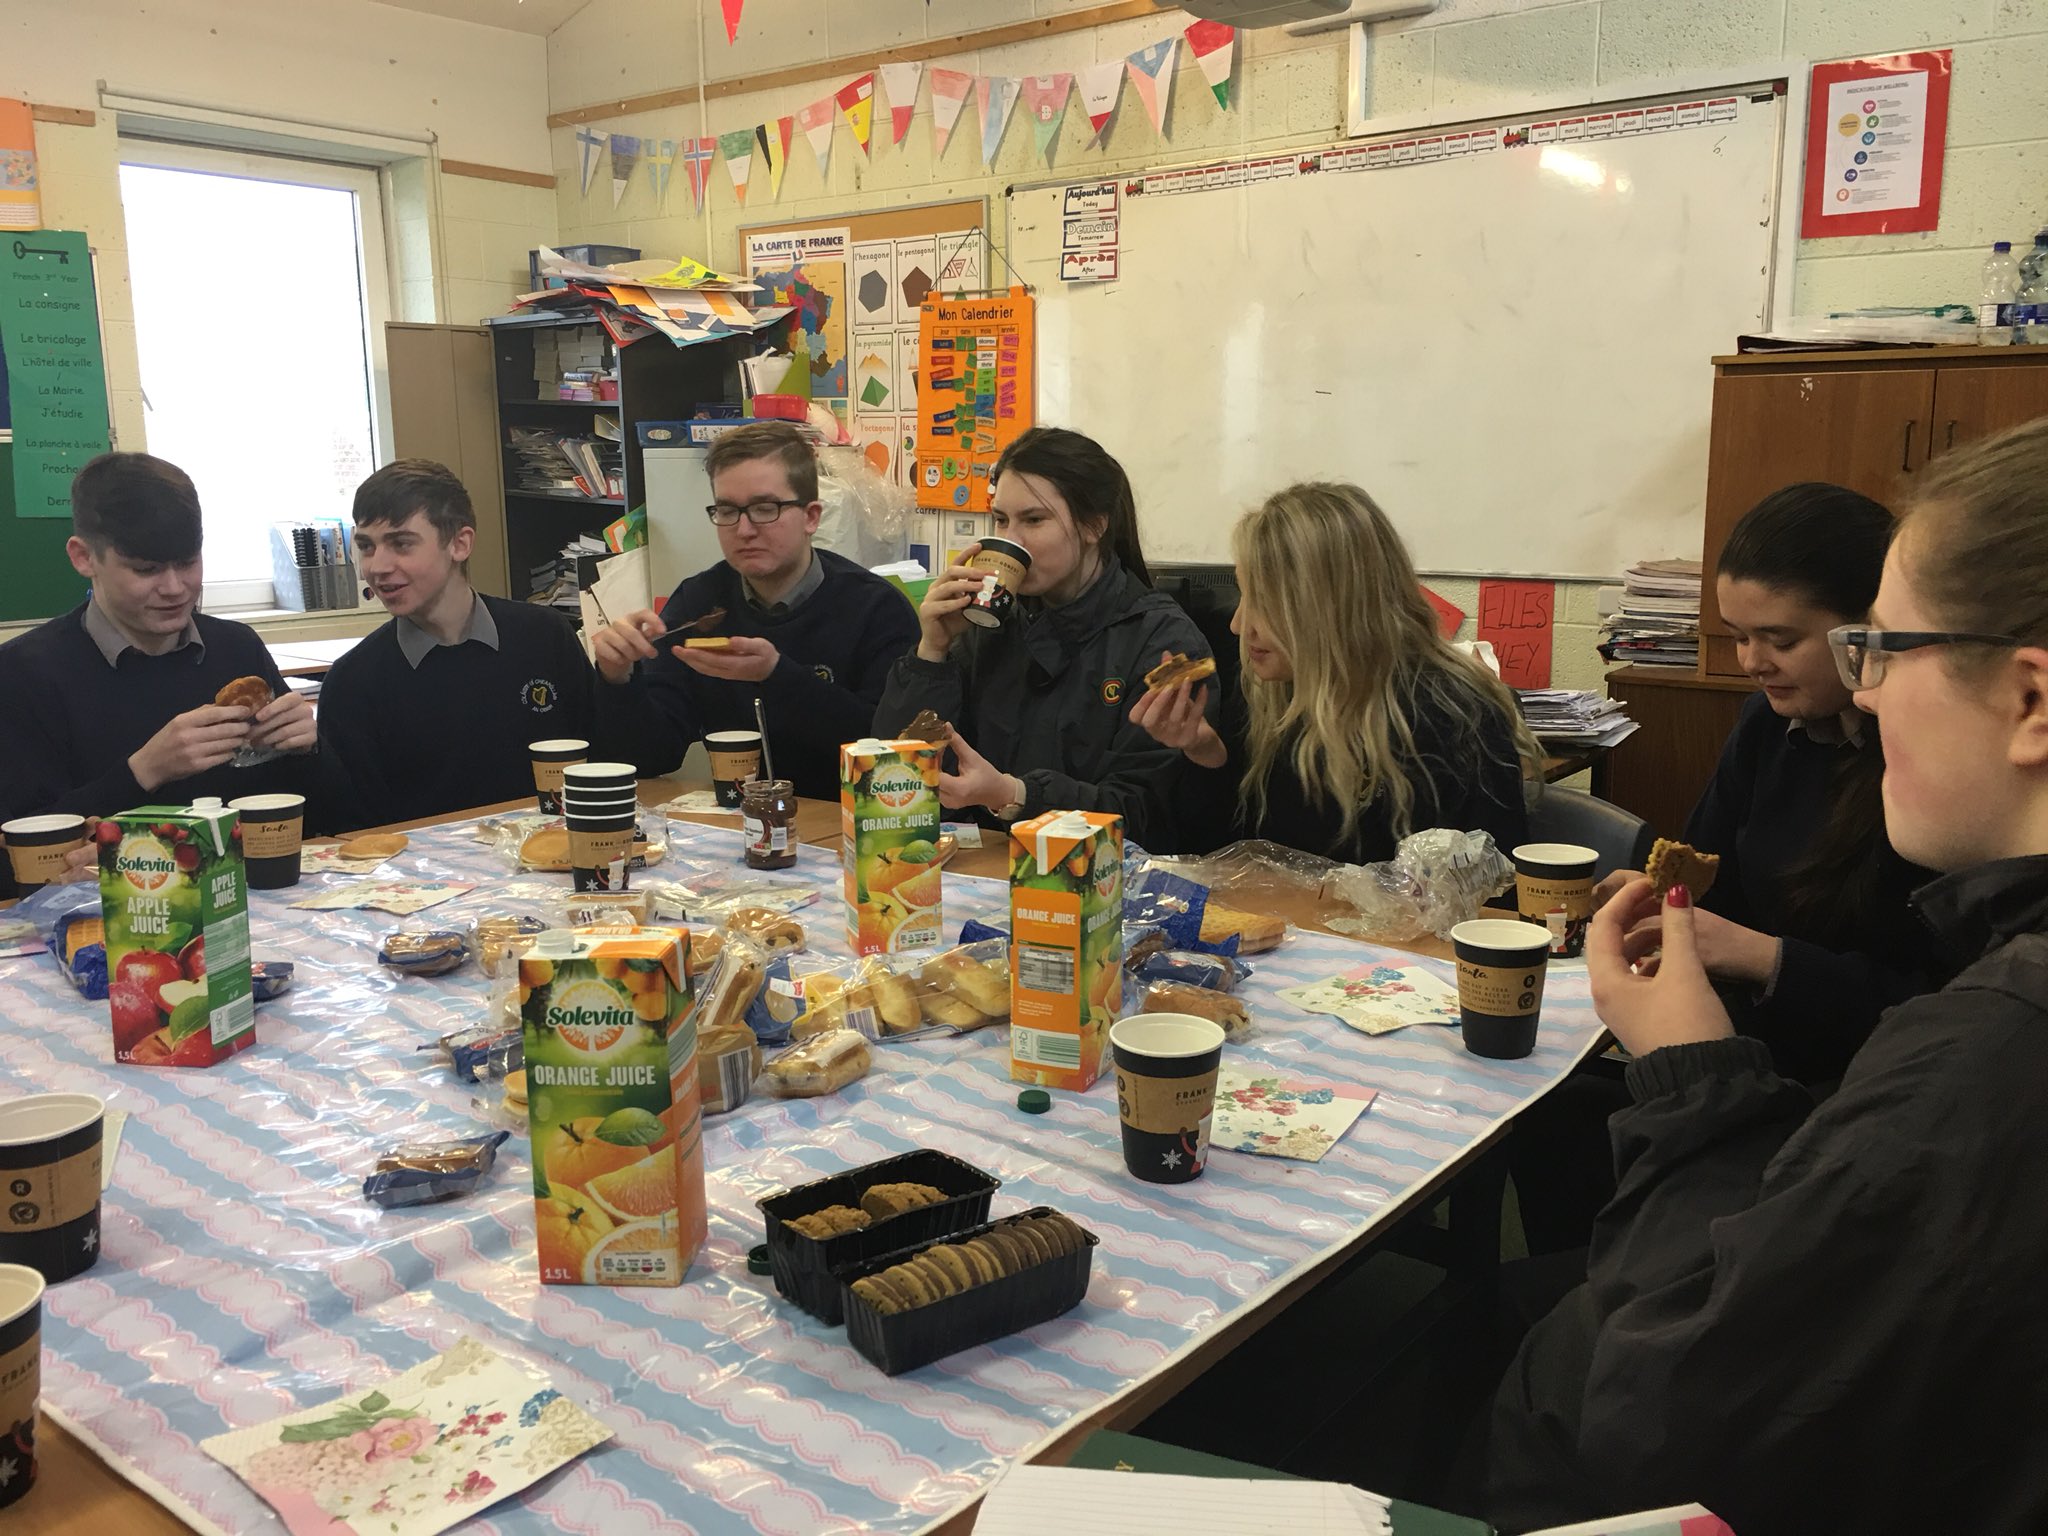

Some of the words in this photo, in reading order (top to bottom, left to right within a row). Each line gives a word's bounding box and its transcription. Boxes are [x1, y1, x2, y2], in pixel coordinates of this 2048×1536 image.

[1588, 122, 1612, 131] mercredi
[1623, 120, 1636, 128] jeudi
[1648, 115, 1672, 124] vendredi
[1682, 112, 1700, 120] samedi
[1710, 106, 1736, 116] dimanche
[1473, 138, 1496, 146] dimanche
[1068, 186, 1115, 200] Aujourd'hui
[1067, 221, 1116, 235] Demain
[752, 243, 763, 252] LA
[766, 240, 792, 250] CARTE
[795, 240, 806, 248] DE
[809, 236, 844, 247] FRANCE
[941, 242, 948, 251] le
[950, 240, 979, 252] triangle
[854, 252, 890, 262] l'hexagone
[904, 248, 935, 258] pentagone
[1064, 254, 1115, 266] Après
[12, 272, 40, 280] French
[60, 274, 79, 283] Year
[18, 297, 32, 308] La
[35, 300, 81, 312] consigne
[938, 308, 957, 320] Mon
[962, 305, 1014, 320] Calendrier
[20, 333, 34, 344] Le
[37, 334, 87, 348] bricolage
[864, 340, 892, 350] pyramide
[903, 336, 910, 346] le
[22, 358, 55, 367] L'hôtel
[58, 358, 70, 368] de
[73, 358, 93, 368] ville
[38, 386, 50, 395] La
[53, 386, 84, 396] Mairie
[42, 407, 84, 419] J'étudie
[902, 422, 910, 432] la
[26, 438, 36, 447] La
[40, 439, 72, 449] planche
[74, 439, 80, 448] à
[83, 440, 102, 449] voile
[871, 778, 923, 794] Solevita
[862, 816, 901, 832] ORANGE
[905, 814, 934, 827] JUICE
[118, 856, 176, 873] Solevita
[212, 871, 237, 894] APPLE
[1526, 886, 1552, 895] FRANK
[213, 886, 237, 909] JUICE
[128, 896, 171, 916] APPLE
[1017, 908, 1049, 922] ORANGE
[1051, 912, 1076, 926] JUICE
[130, 916, 170, 934] JUICE
[864, 945, 880, 953] 1.5L
[548, 1006, 634, 1026] Solevita
[534, 1064, 600, 1086] ORANGE
[606, 1066, 656, 1085] JUICE
[1176, 1088, 1208, 1100] FRANK
[545, 1268, 571, 1280] 1.5L
